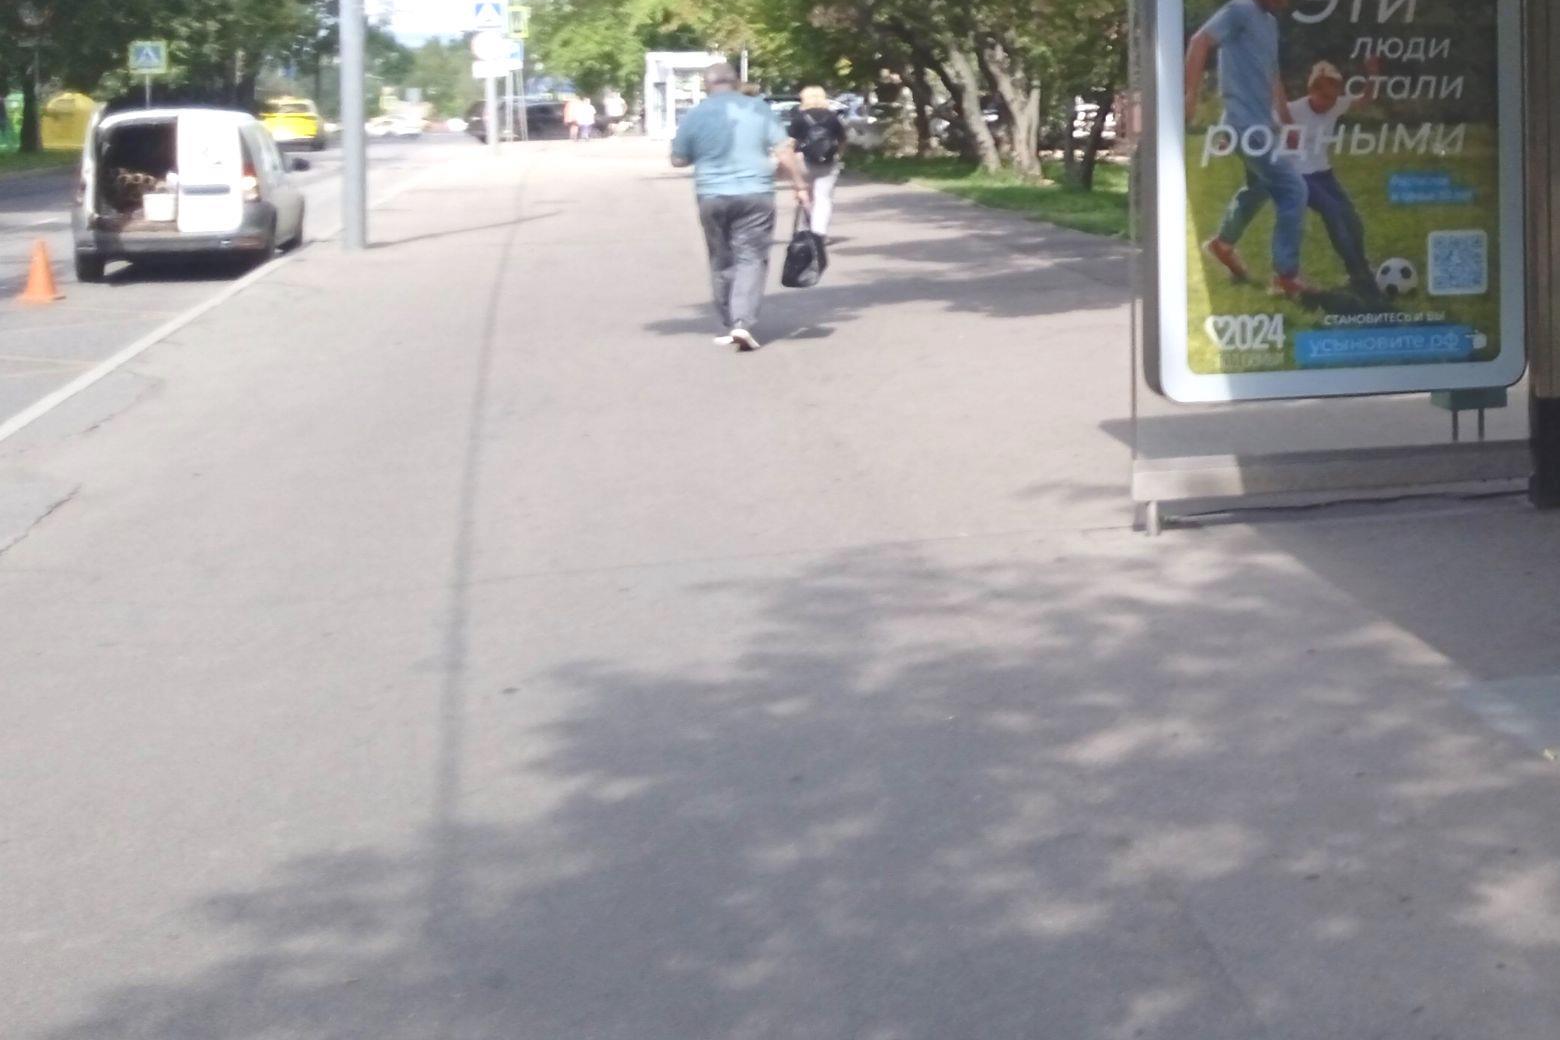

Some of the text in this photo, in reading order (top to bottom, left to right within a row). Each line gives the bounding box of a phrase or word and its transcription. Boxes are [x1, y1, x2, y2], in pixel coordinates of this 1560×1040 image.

[1350, 36, 1451, 62] люди
[1344, 75, 1465, 100] стали
[1201, 122, 1467, 168] родными
[1221, 312, 1286, 350] 2024
[1309, 331, 1460, 356] усыновитерф
